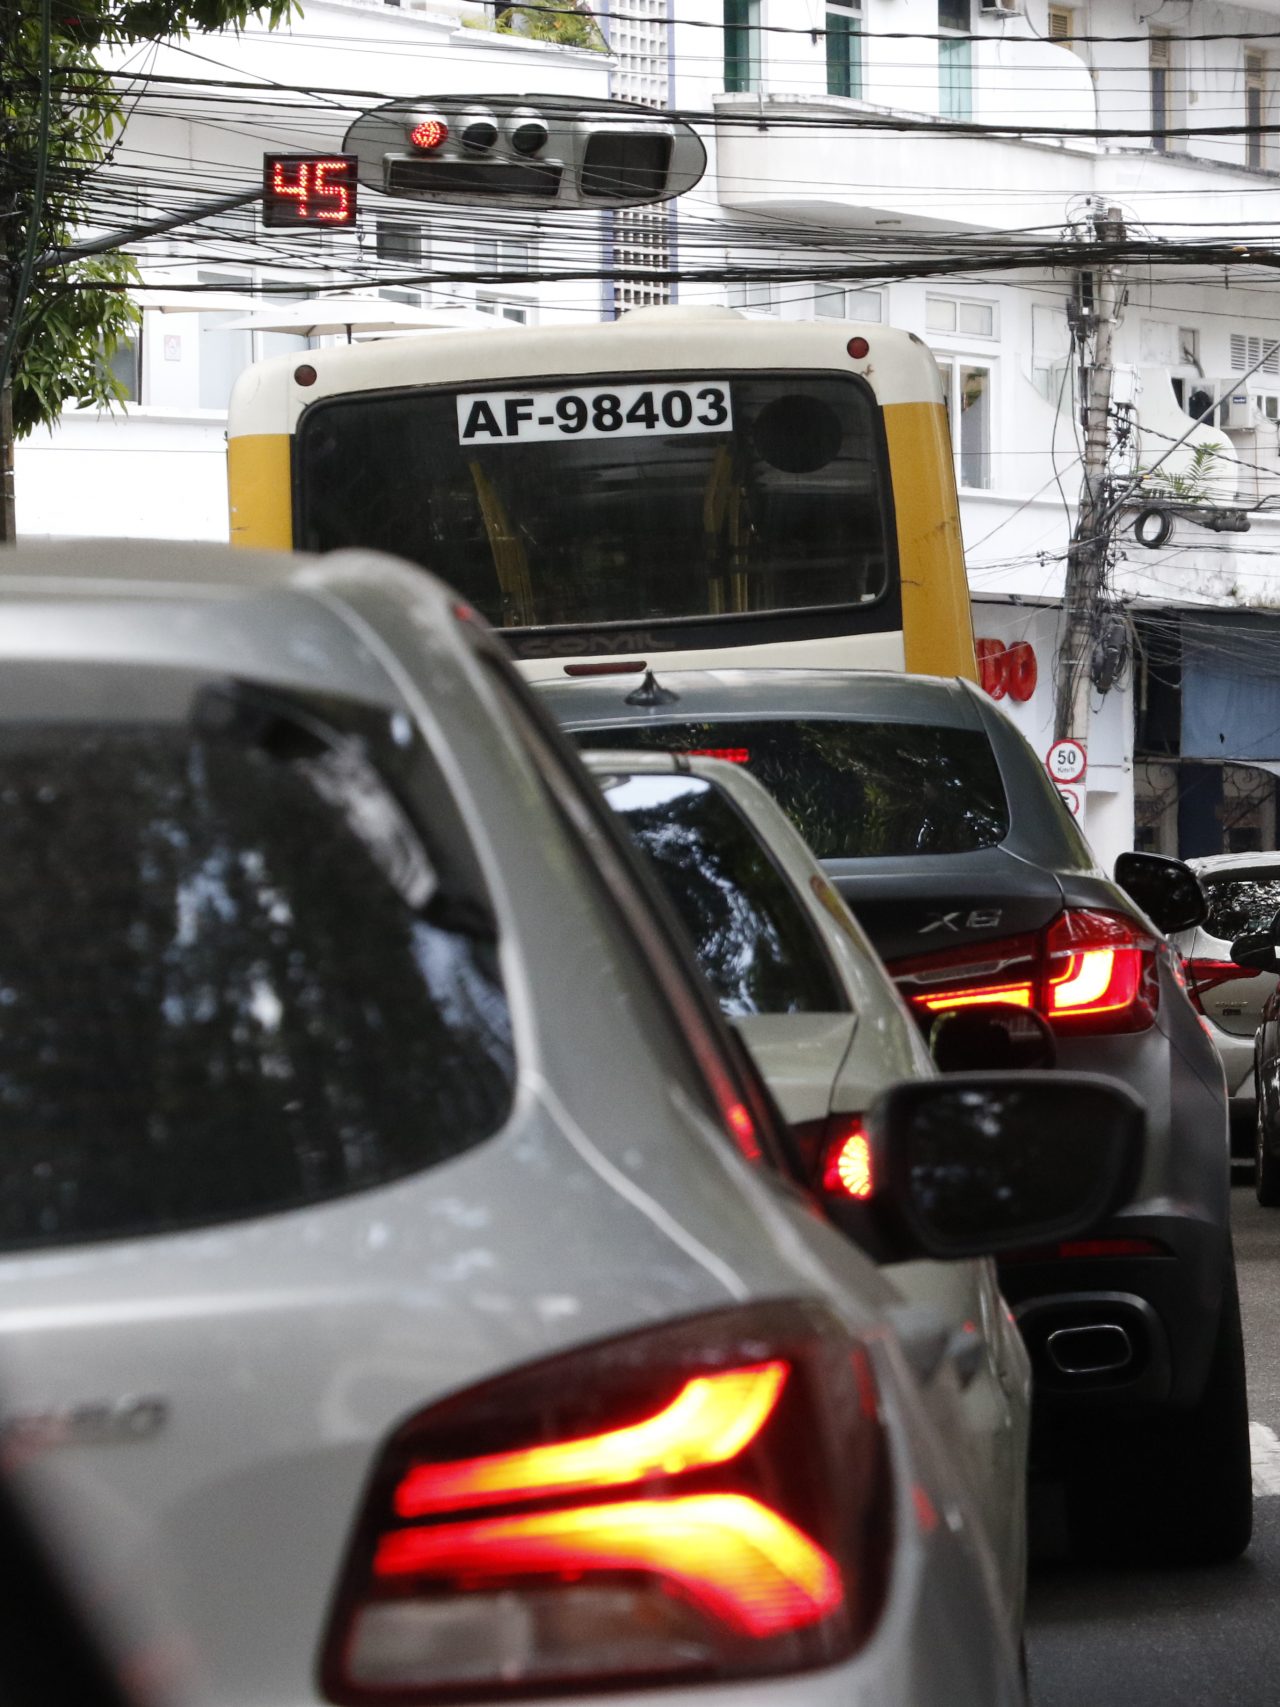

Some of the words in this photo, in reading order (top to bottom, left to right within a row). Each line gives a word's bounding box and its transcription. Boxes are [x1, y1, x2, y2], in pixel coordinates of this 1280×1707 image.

[274, 162, 348, 219] 45
[462, 387, 729, 439] AF-98403
[517, 633, 677, 656] COMIL
[1057, 749, 1076, 766] 50
[917, 909, 1002, 934] X6
